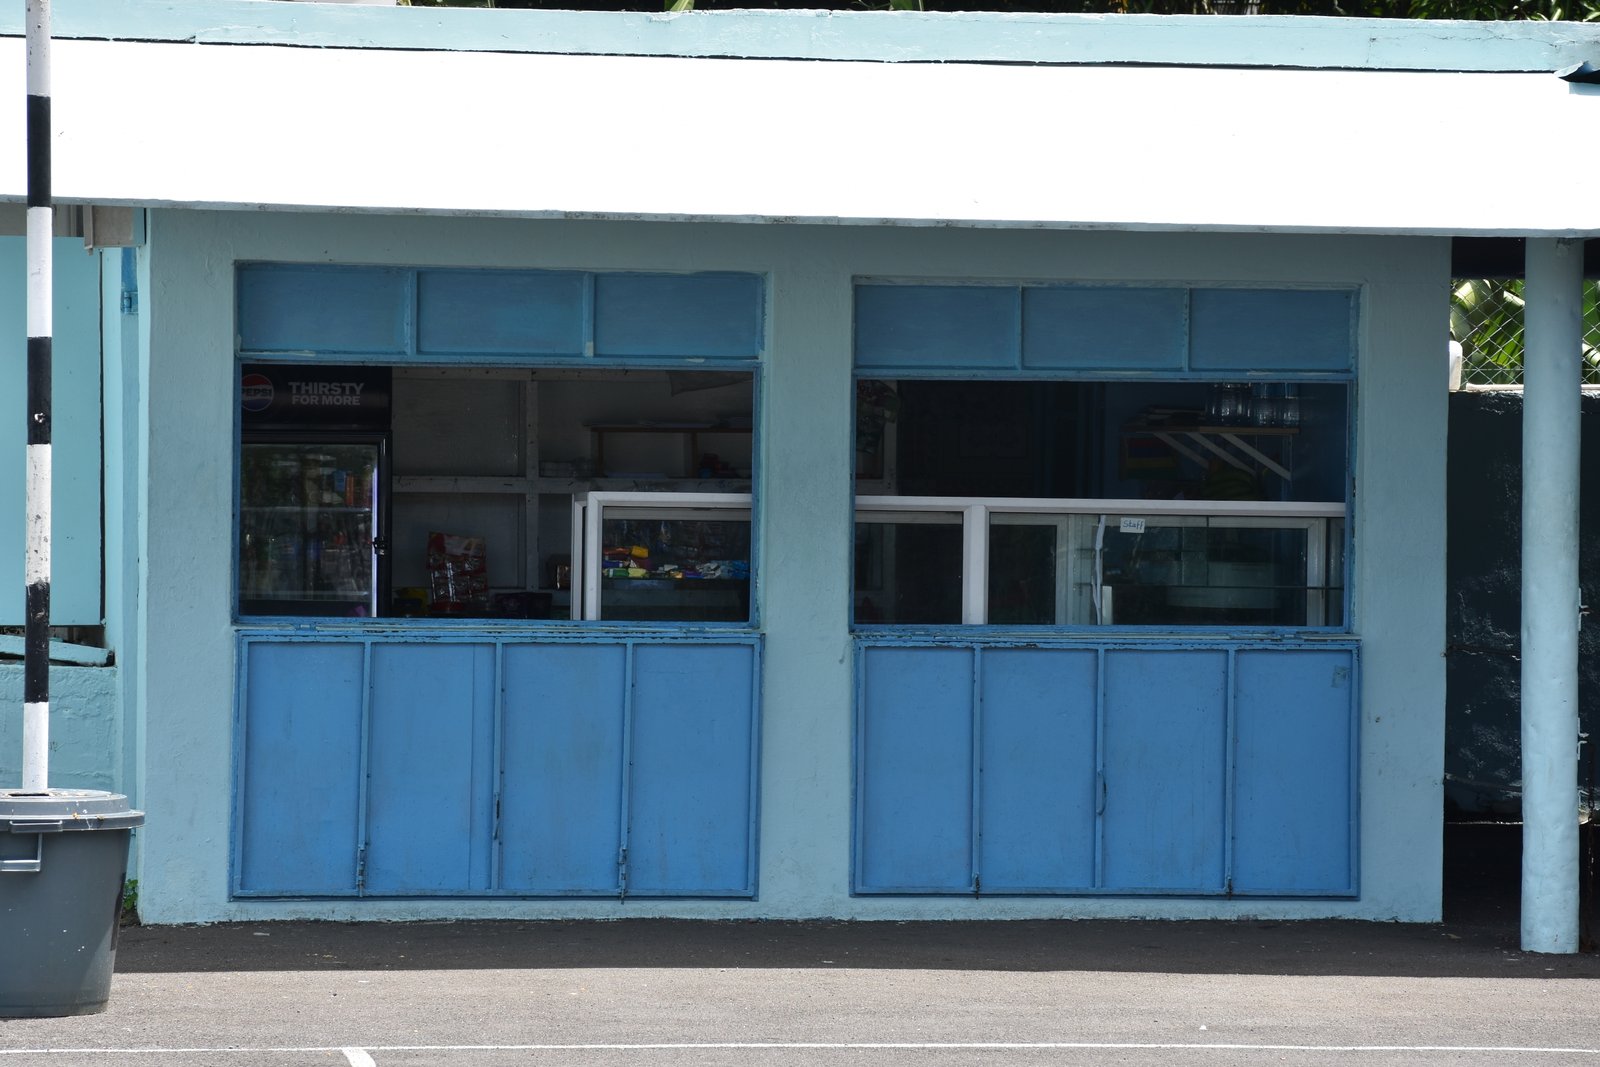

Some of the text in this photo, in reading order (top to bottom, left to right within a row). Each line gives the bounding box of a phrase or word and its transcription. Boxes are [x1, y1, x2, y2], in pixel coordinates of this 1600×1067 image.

[288, 382, 364, 395] THIRSTY
[292, 395, 361, 406] FOR MORE
[1122, 519, 1144, 530] Staff
